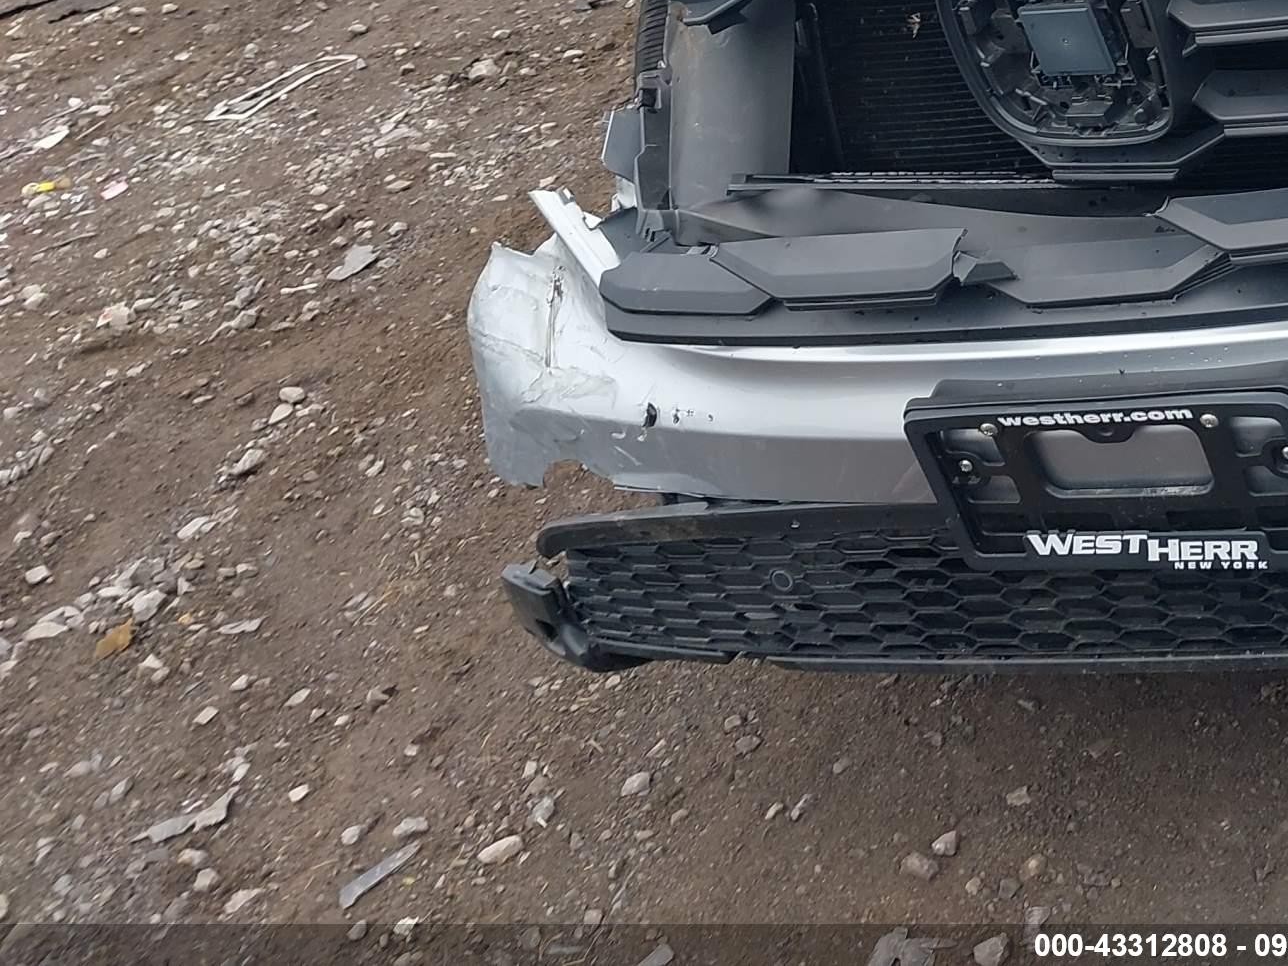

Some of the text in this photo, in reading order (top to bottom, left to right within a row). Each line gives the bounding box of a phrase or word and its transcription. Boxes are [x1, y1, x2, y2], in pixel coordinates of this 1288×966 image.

[998, 409, 1193, 427] westherr.com
[1174, 561, 1268, 570] NEW YORK
